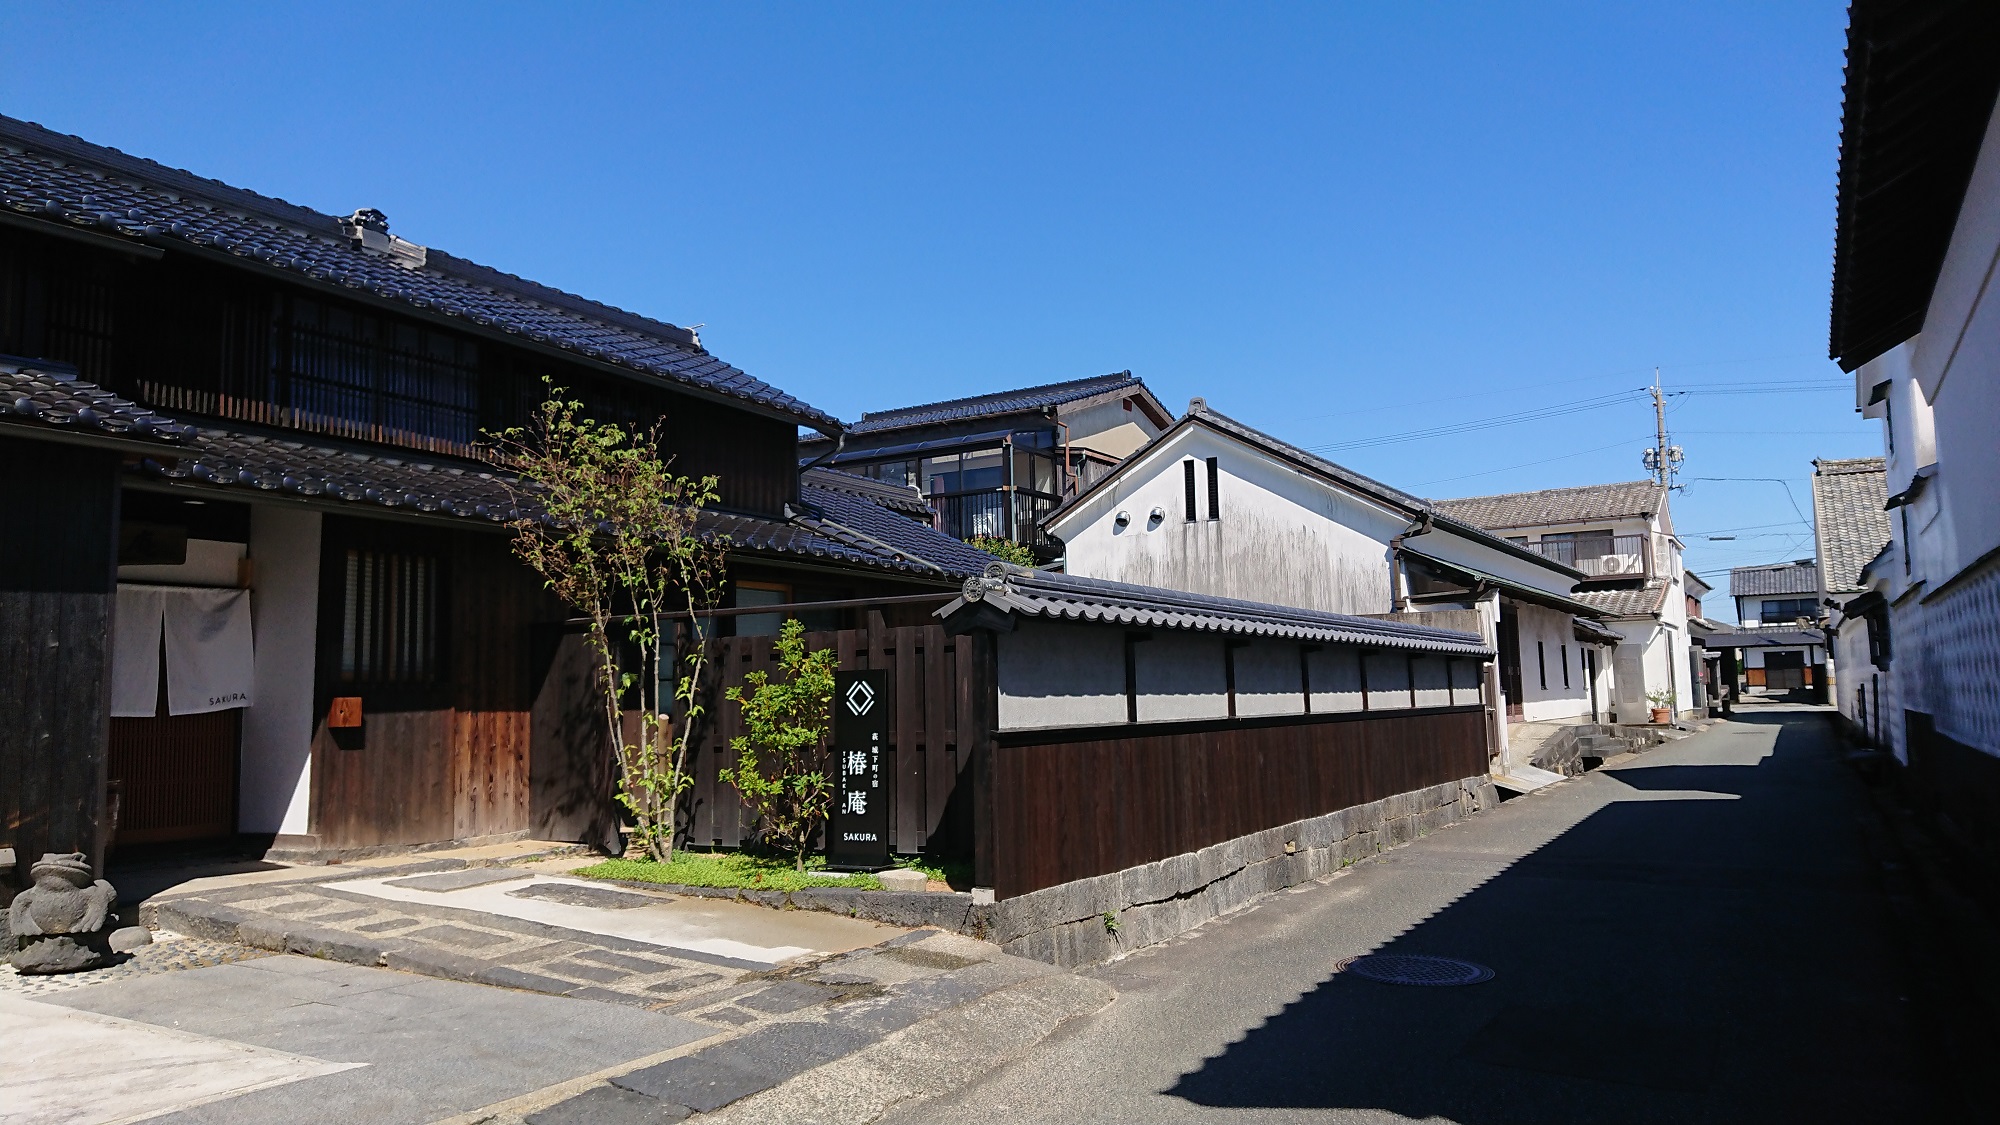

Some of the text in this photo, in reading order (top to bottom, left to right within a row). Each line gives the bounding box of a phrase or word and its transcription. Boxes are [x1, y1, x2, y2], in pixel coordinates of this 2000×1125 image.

[209, 692, 247, 706] SAKURA
[847, 751, 867, 814] 椿庵
[841, 803, 846, 814] AN
[843, 832, 878, 842] SAKURA
